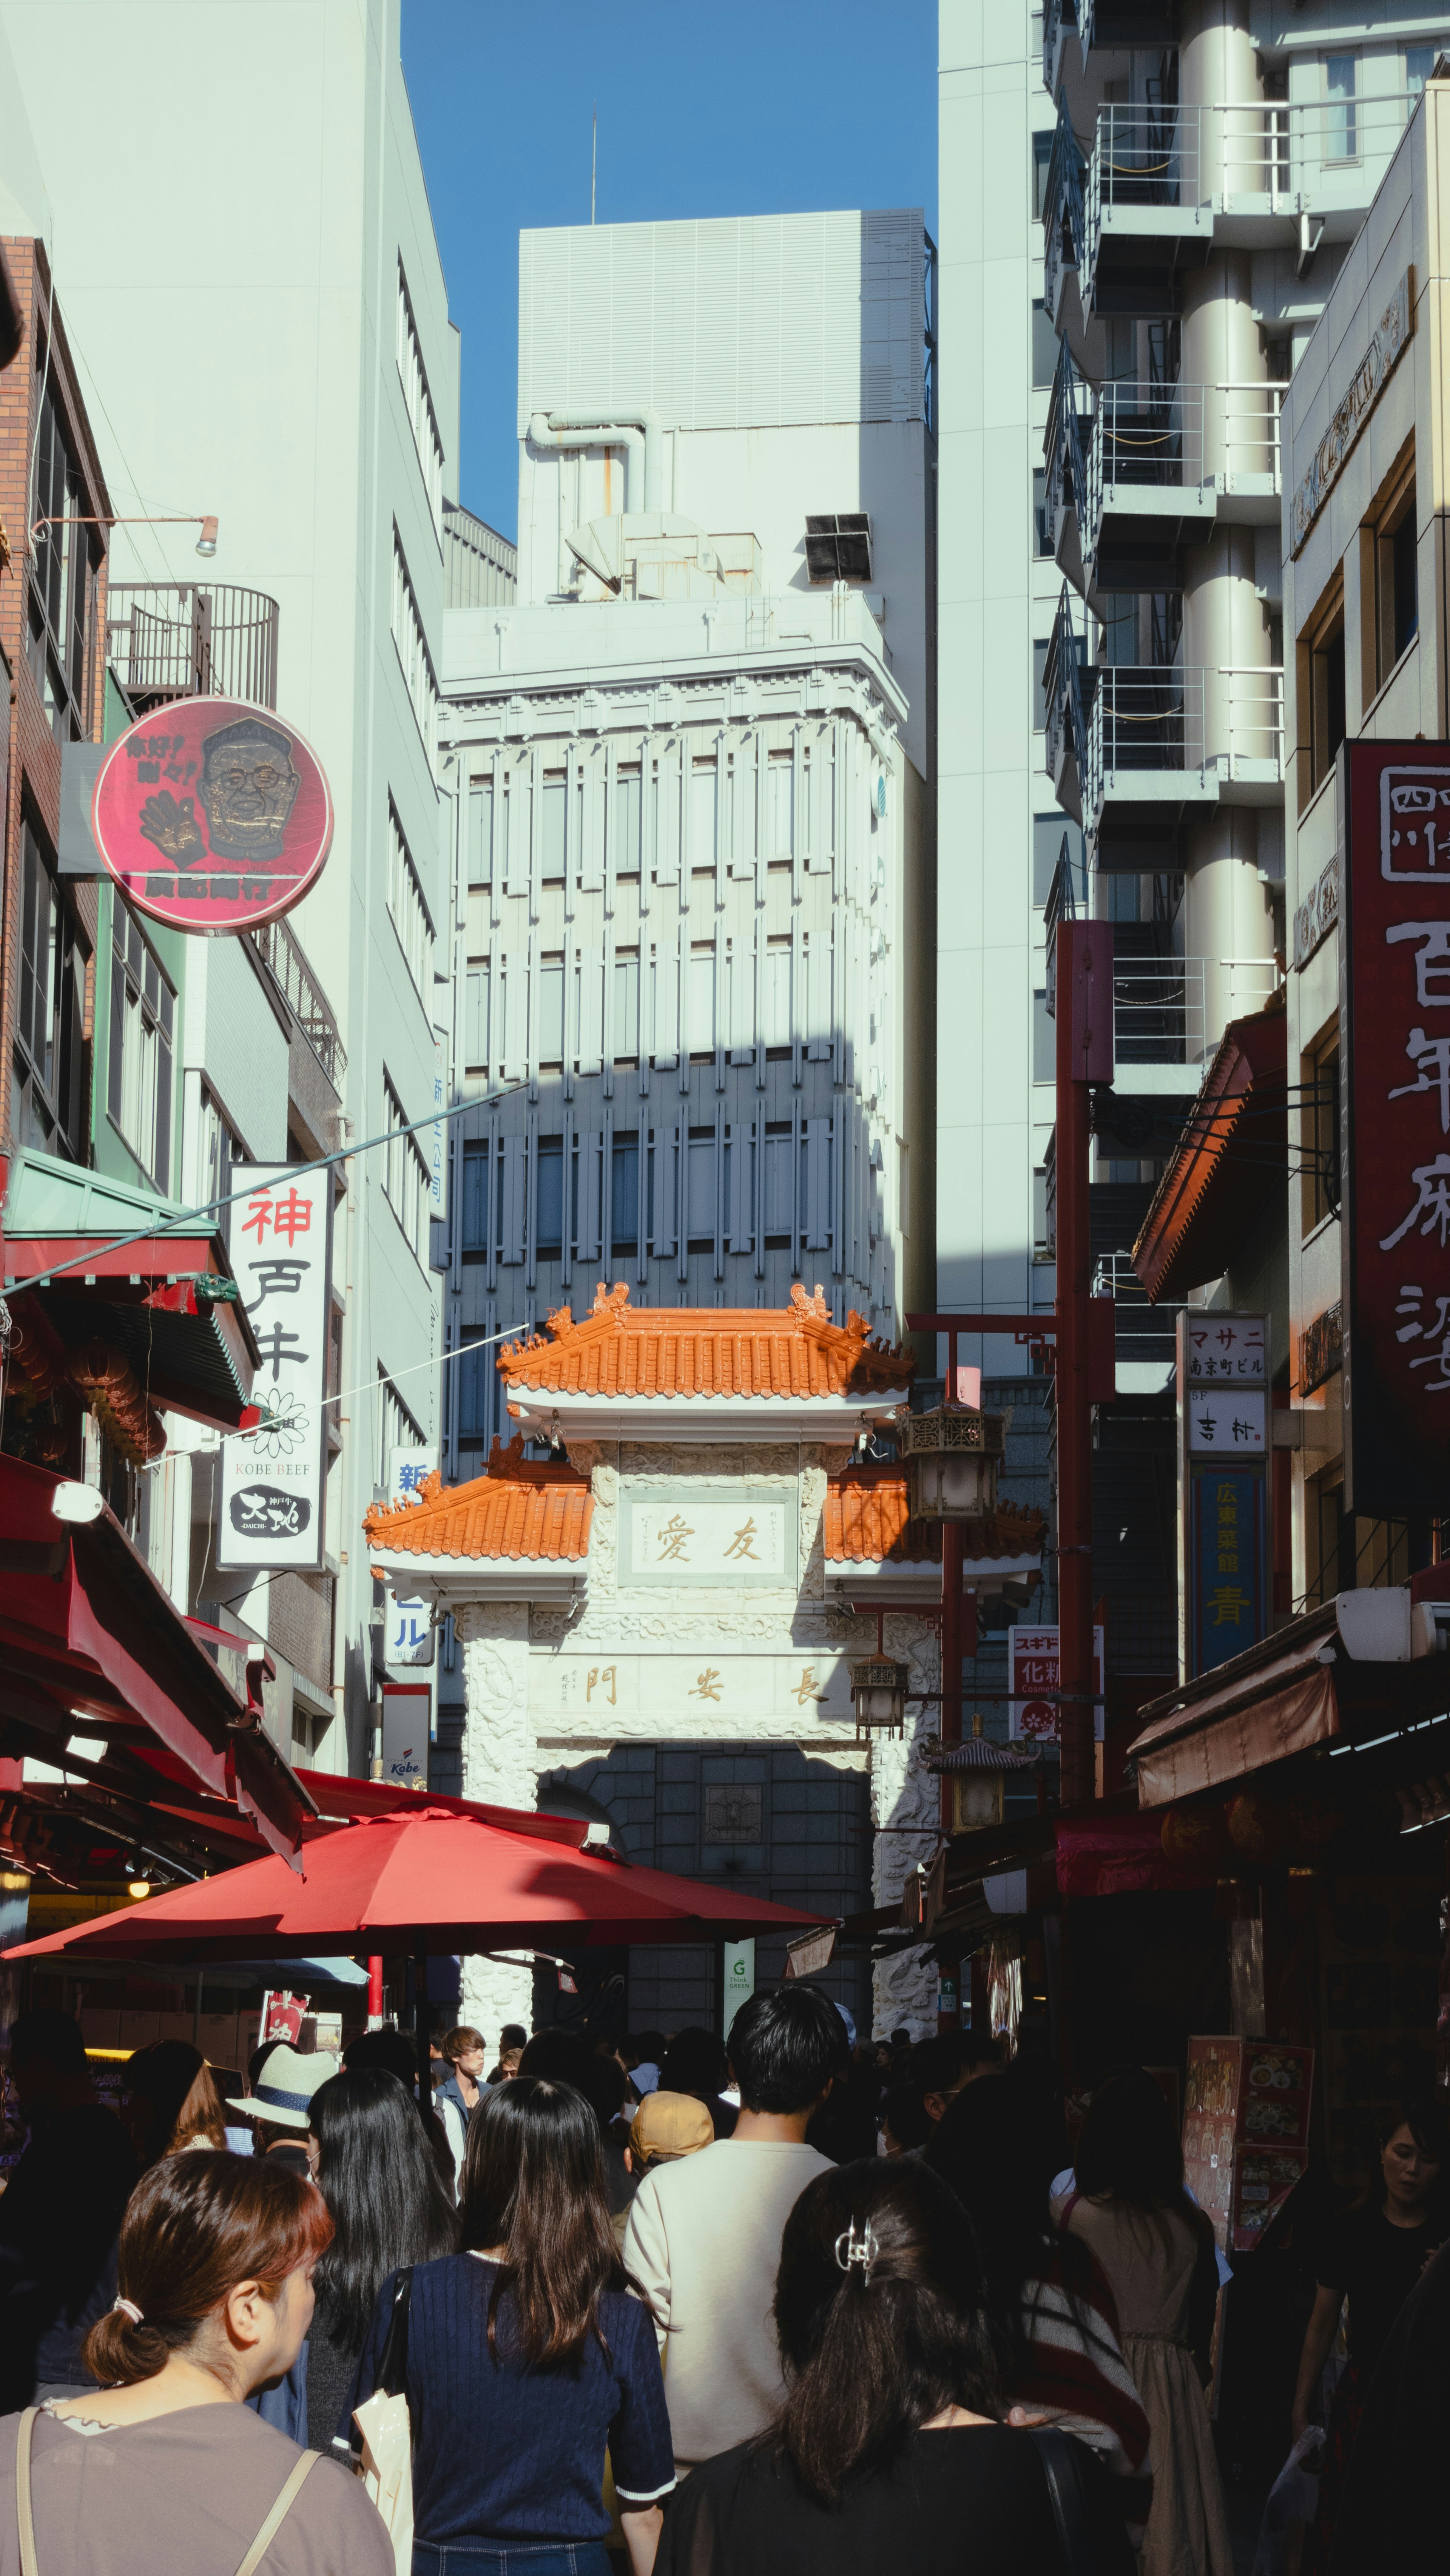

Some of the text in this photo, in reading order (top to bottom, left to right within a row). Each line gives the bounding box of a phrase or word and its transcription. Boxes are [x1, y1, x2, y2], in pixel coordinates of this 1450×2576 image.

[242, 1187, 312, 1382] 神戸牛
[1189, 1328, 1265, 1351] マサニ
[1190, 1357, 1263, 1376] 南京町ビル
[1192, 1391, 1207, 1400] 5F
[236, 1464, 310, 1475] KOBE BEEF
[1217, 1483, 1238, 1573] 広東菜館
[391, 1762, 420, 1775] Kobe
